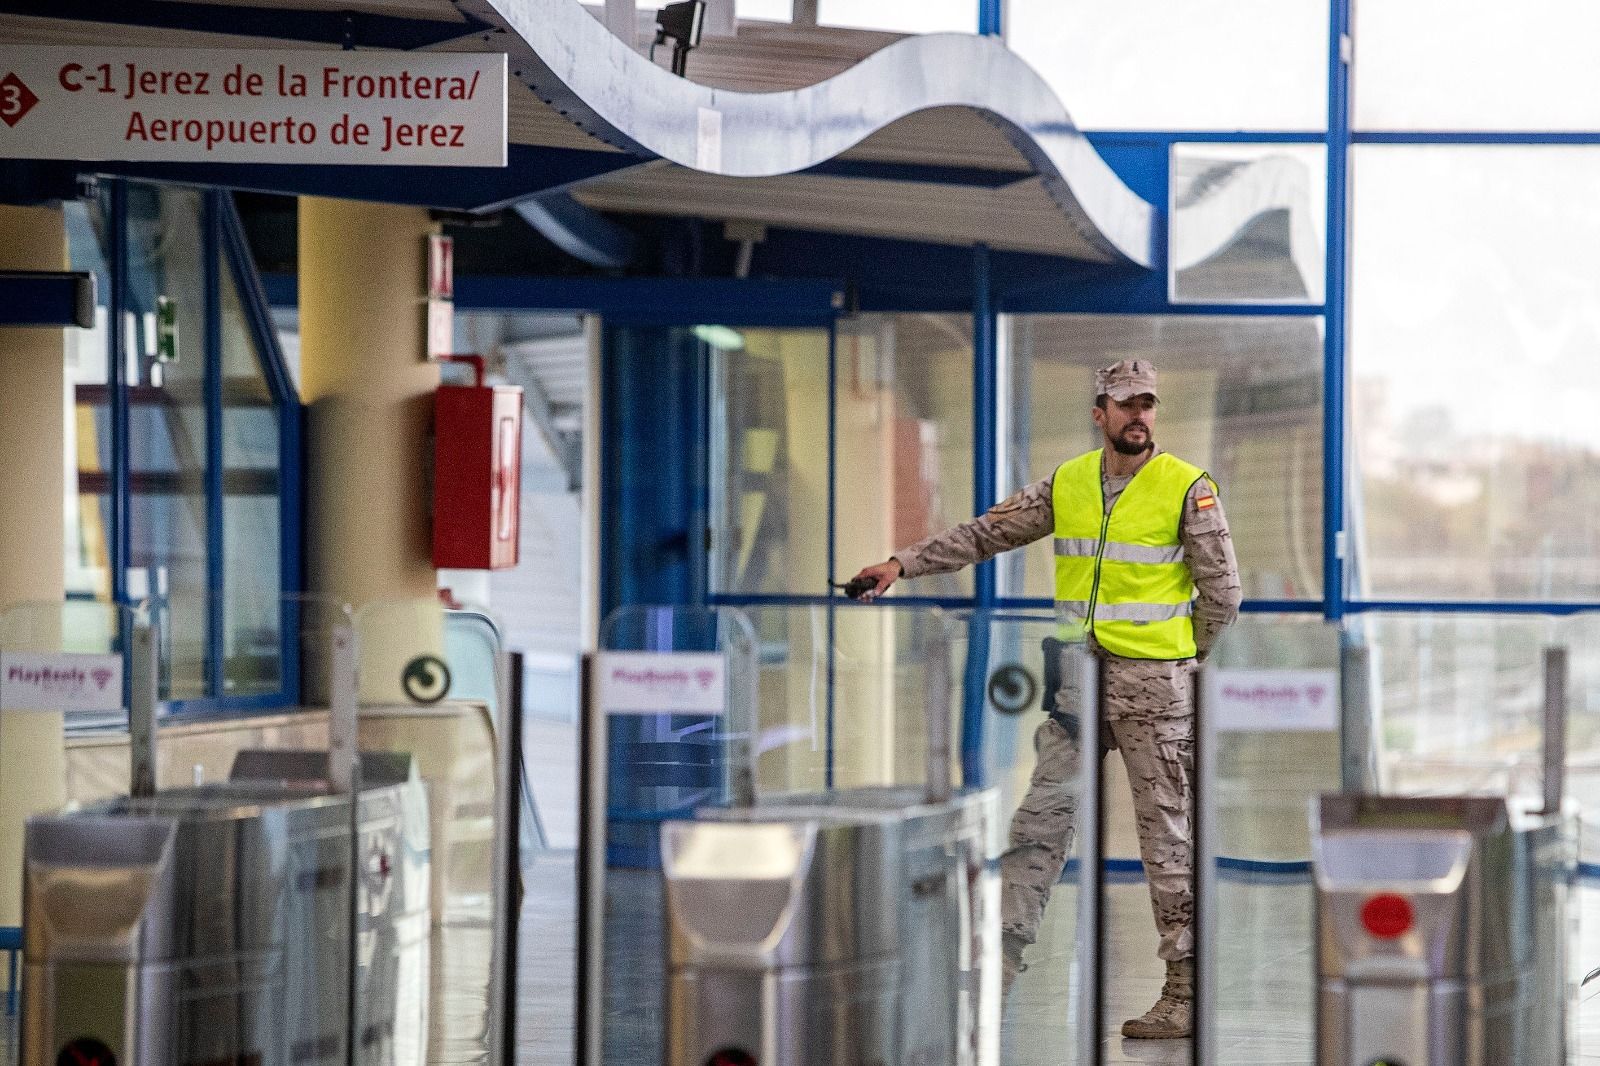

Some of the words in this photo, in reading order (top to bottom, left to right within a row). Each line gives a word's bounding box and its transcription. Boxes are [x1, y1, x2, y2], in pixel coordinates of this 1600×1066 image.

[58, 63, 116, 92] C-1
[124, 63, 210, 100] Jerez
[223, 64, 263, 96] de
[278, 65, 307, 97] la
[323, 67, 480, 100] Frontera/
[1, 85, 22, 116] 3
[125, 112, 317, 150] Aeropuerto
[330, 114, 369, 145] de
[381, 116, 465, 151] Jerez
